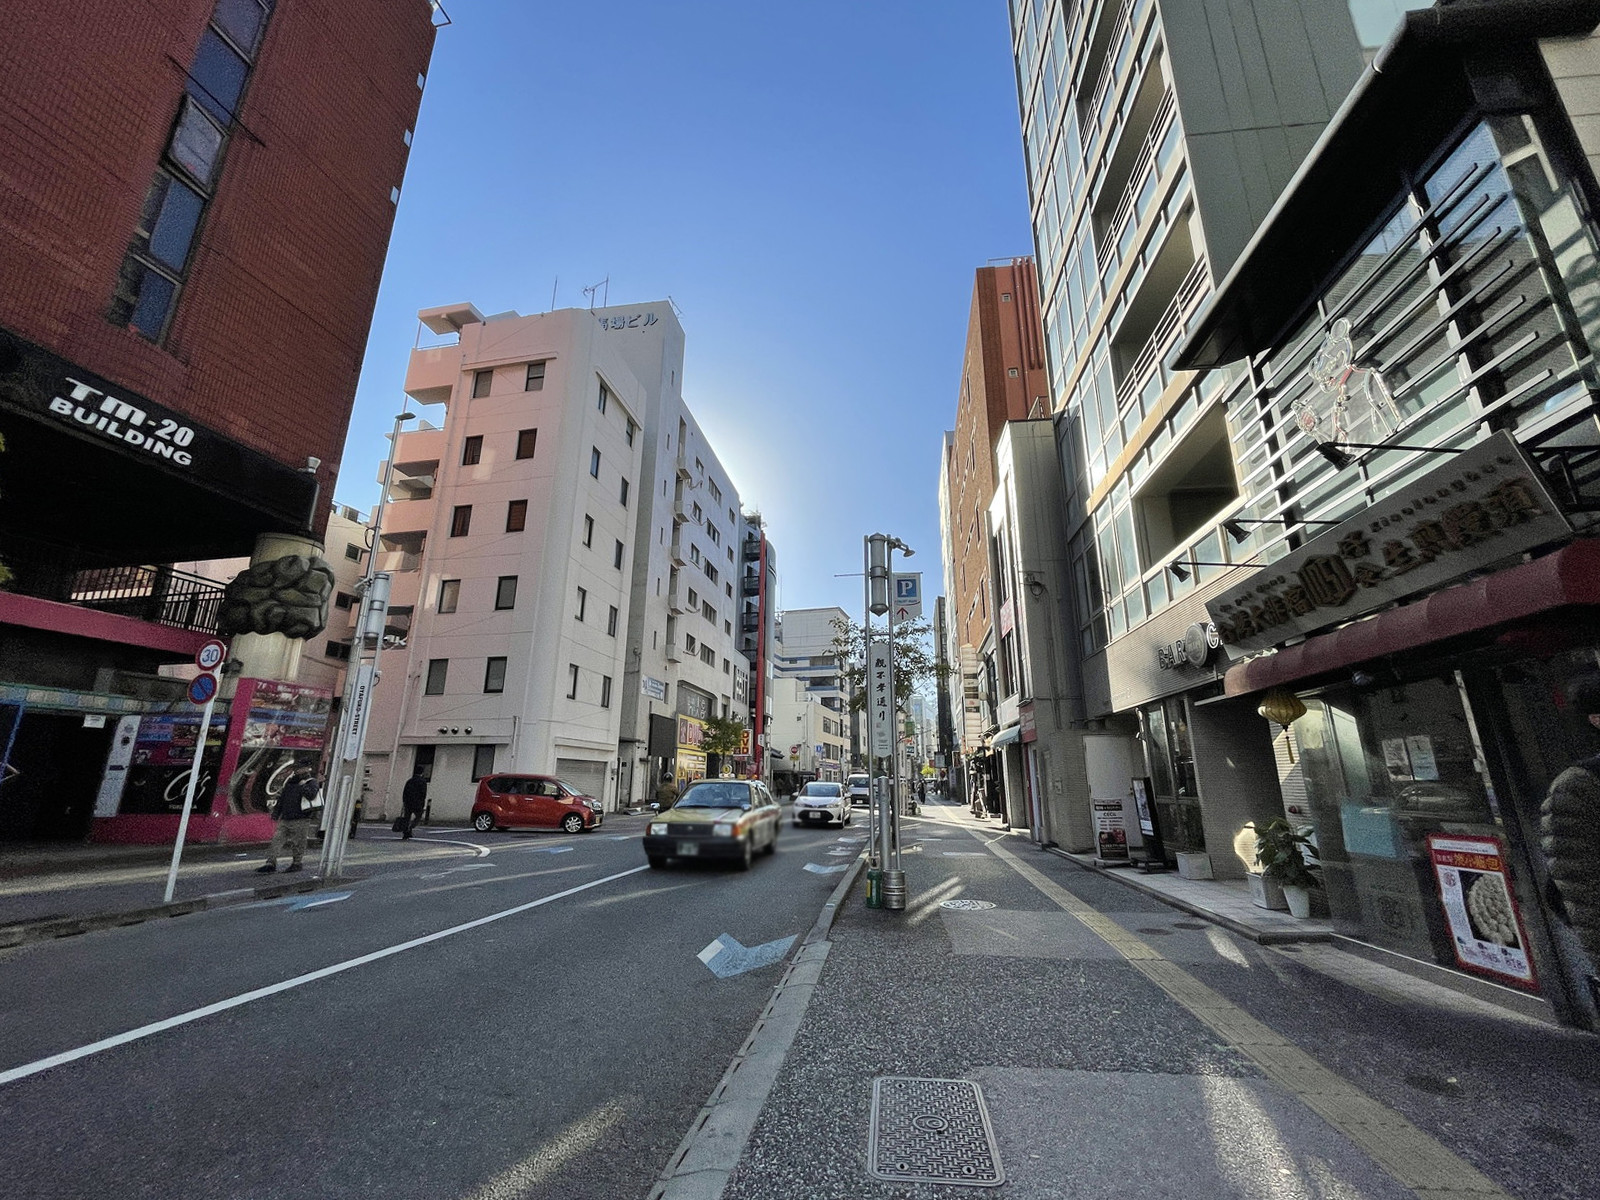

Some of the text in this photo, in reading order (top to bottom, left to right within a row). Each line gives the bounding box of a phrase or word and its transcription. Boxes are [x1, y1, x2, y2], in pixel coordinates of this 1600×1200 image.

[49, 397, 193, 467] BUILDING
[901, 580, 913, 596] P
[202, 649, 219, 662] 30
[1159, 640, 1187, 671] BAR
[874, 657, 888, 722] 親不孝通り
[742, 729, 751, 756] DVD
